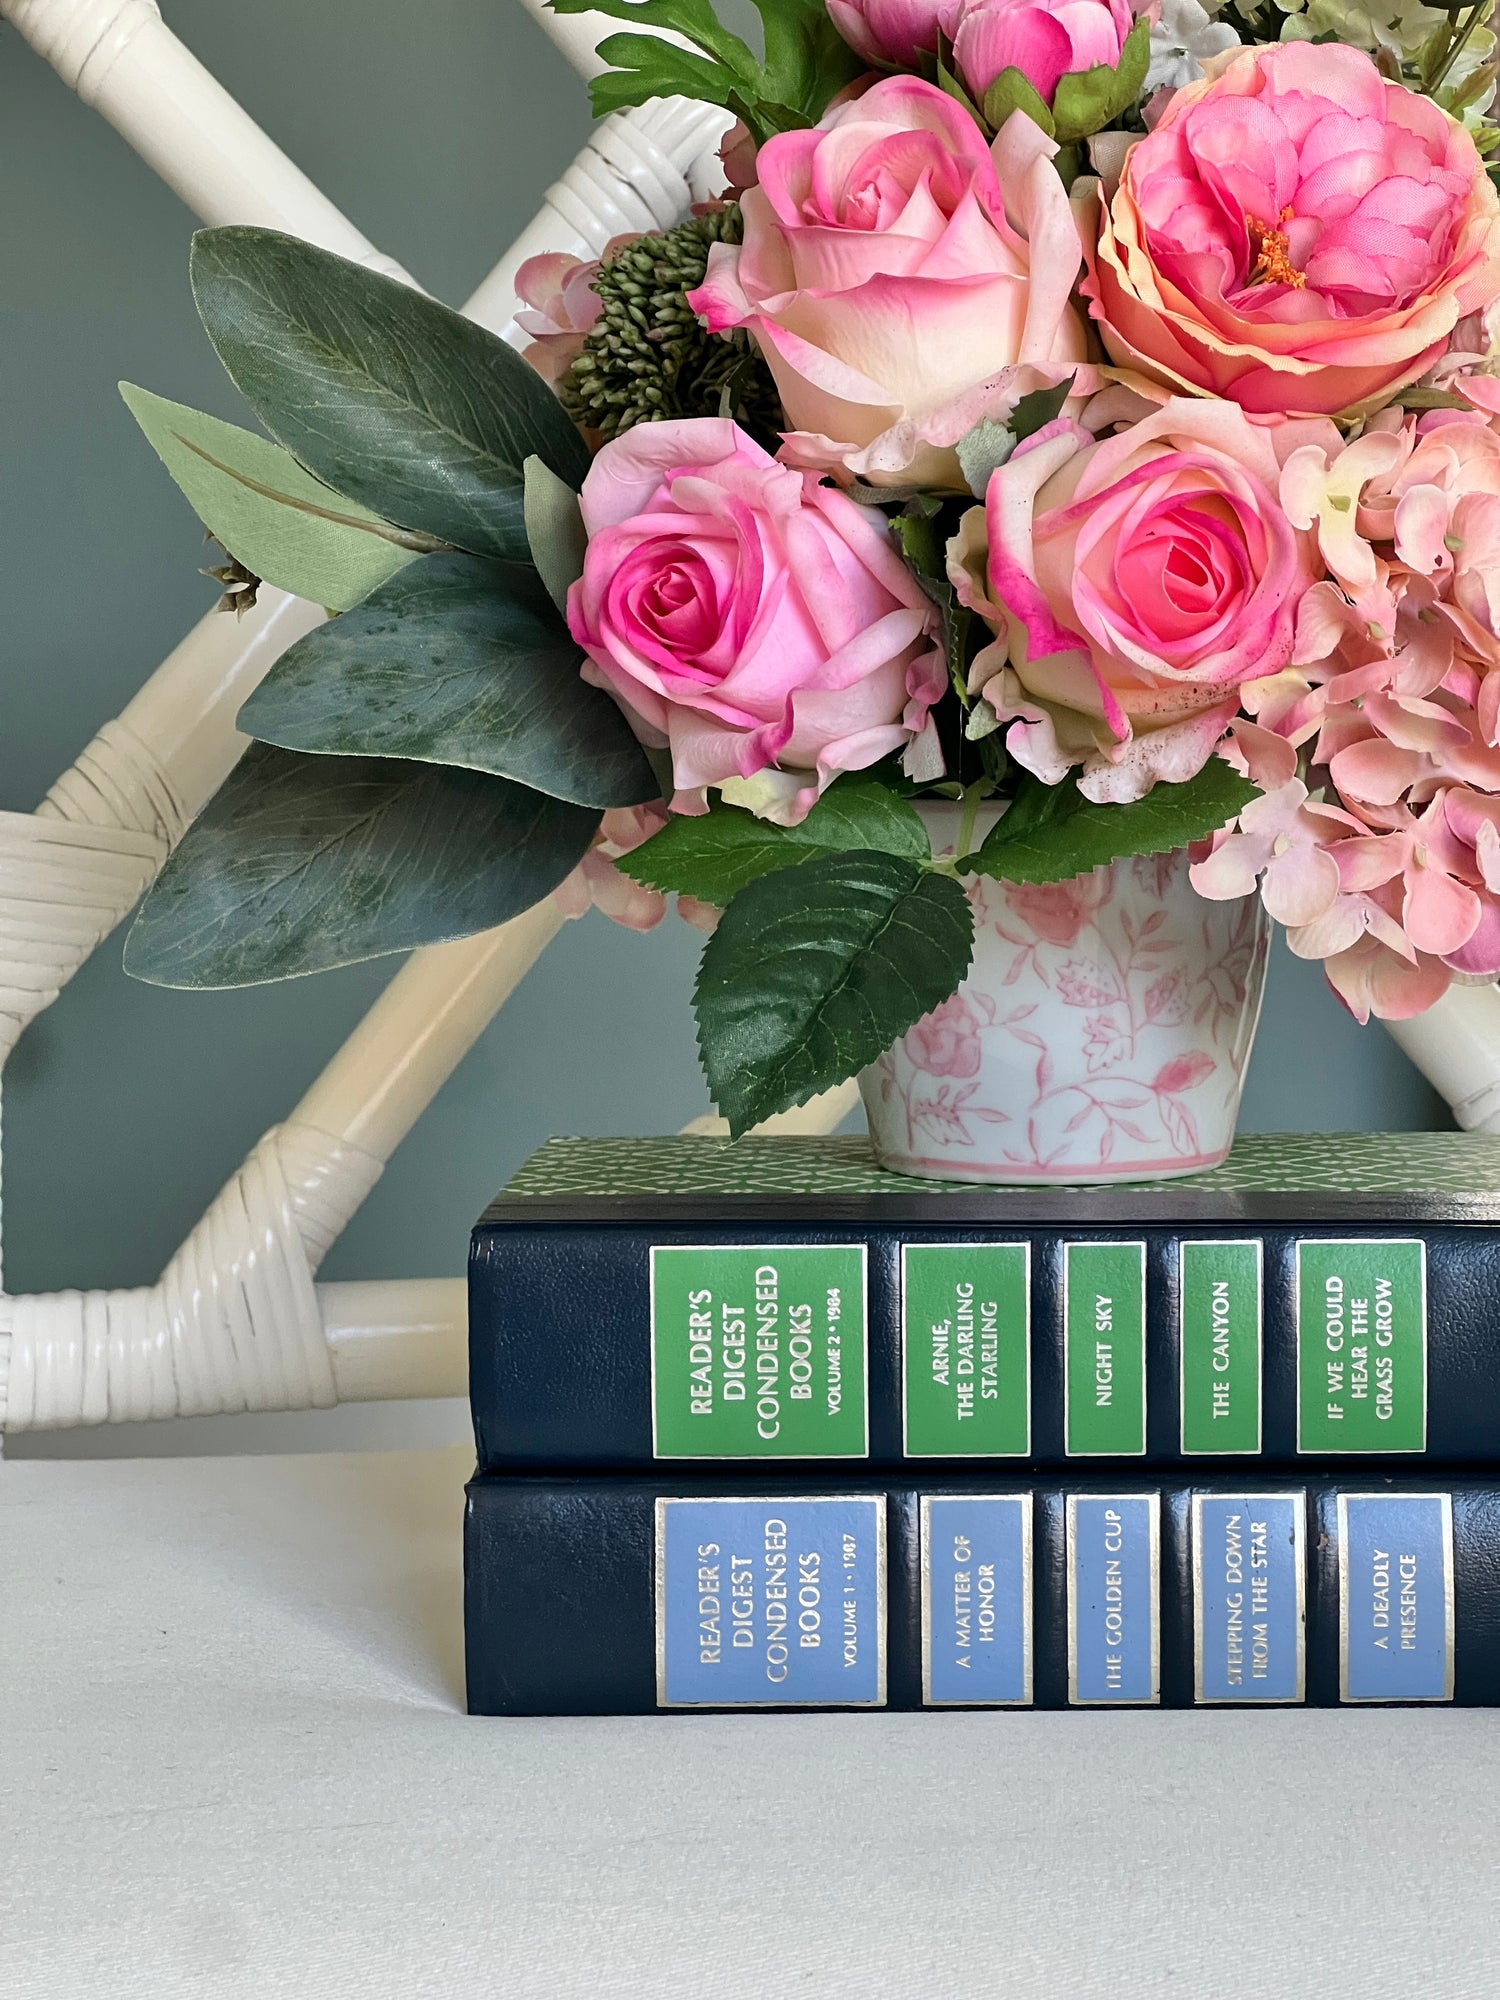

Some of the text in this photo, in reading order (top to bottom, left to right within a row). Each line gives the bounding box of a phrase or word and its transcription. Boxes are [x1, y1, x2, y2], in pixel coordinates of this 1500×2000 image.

[688, 1289, 713, 1414] READER'S
[722, 1302, 746, 1401] DIGEST
[755, 1265, 780, 1439] CONDENSED
[788, 1303, 813, 1400] BOOKS
[826, 1287, 842, 1416] VOLUME 2 1984
[931, 1318, 952, 1386] ARNIE,
[956, 1282, 974, 1421] THE DARLING
[980, 1301, 998, 1400] STARLING
[1095, 1294, 1113, 1406] NIGHT SKY
[1211, 1281, 1230, 1420] THE CANYON
[1325, 1275, 1345, 1420] IF WE COULD
[1350, 1297, 1368, 1399] HEAR THE
[1374, 1277, 1393, 1420] GRASS GROW
[697, 1542, 721, 1664] READER'S
[730, 1554, 754, 1648] DIGEST
[764, 1518, 788, 1683] CONDENSED
[798, 1552, 821, 1648] BOOKS
[842, 1533, 857, 1569] 1987
[953, 1534, 972, 1669] A MATTER OF
[977, 1563, 995, 1642] HONOR
[1104, 1509, 1122, 1689] THE GOLDEN CUP
[1225, 1514, 1243, 1686] STEPPING DOWN
[1250, 1520, 1268, 1679] FROM THE STAR
[1372, 1548, 1390, 1650] A DEADLY
[1399, 1553, 1417, 1650] PRESENCE
[843, 1600, 857, 1668] VOLUME
